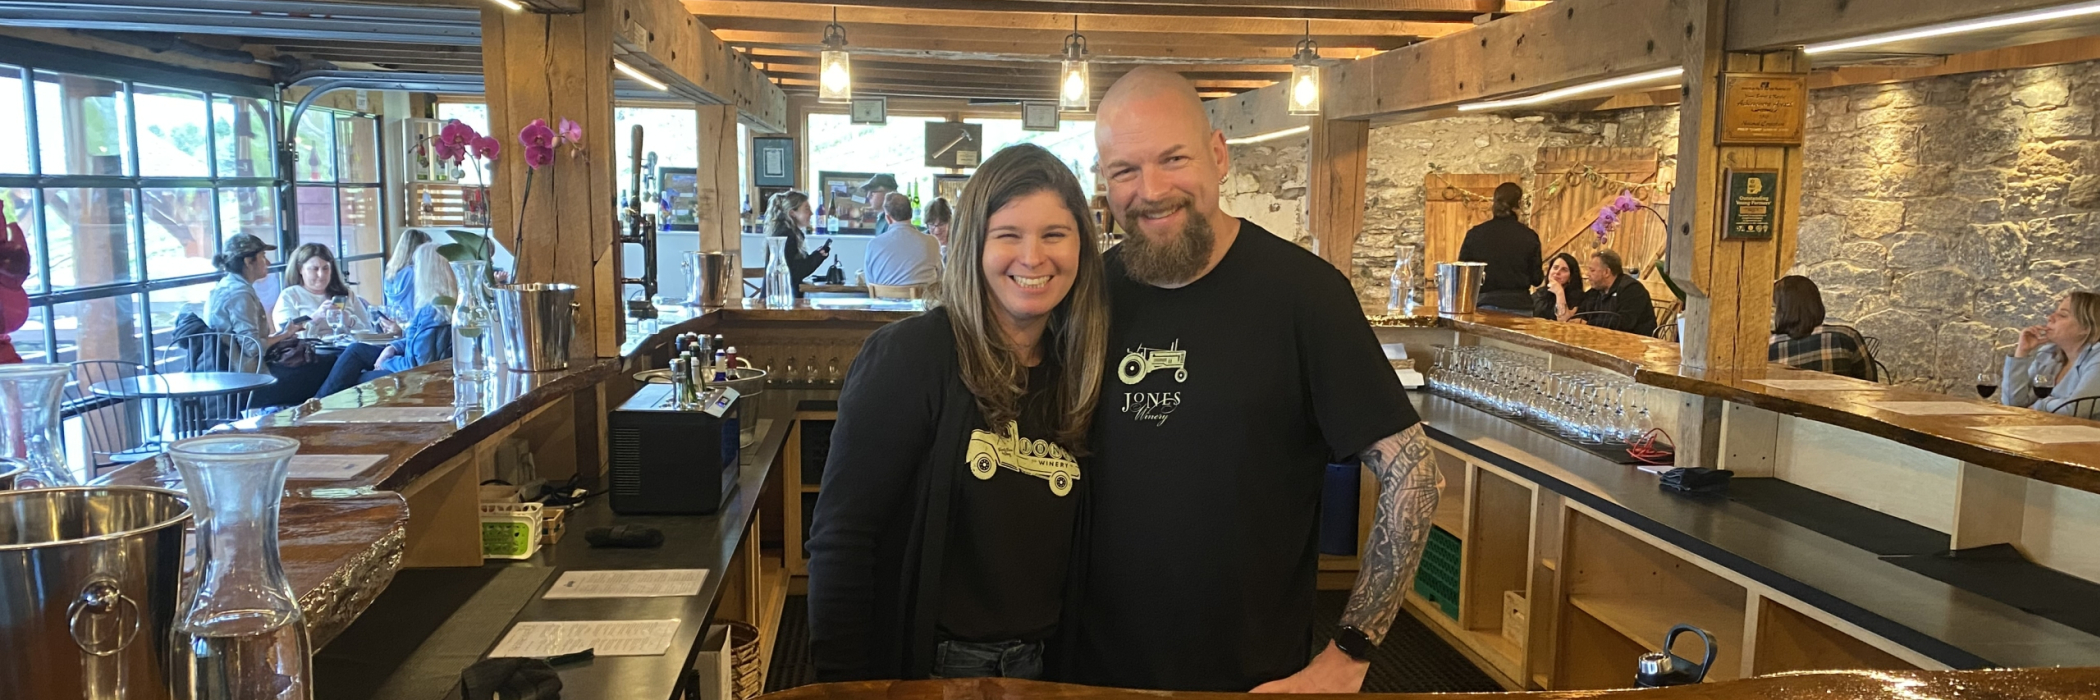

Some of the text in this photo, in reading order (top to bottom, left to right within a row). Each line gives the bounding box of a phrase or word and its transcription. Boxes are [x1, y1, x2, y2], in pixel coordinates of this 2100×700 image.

[1121, 391, 1181, 412] JONES
[1130, 400, 1176, 427] Winery
[1038, 459, 1069, 469] WINERY
